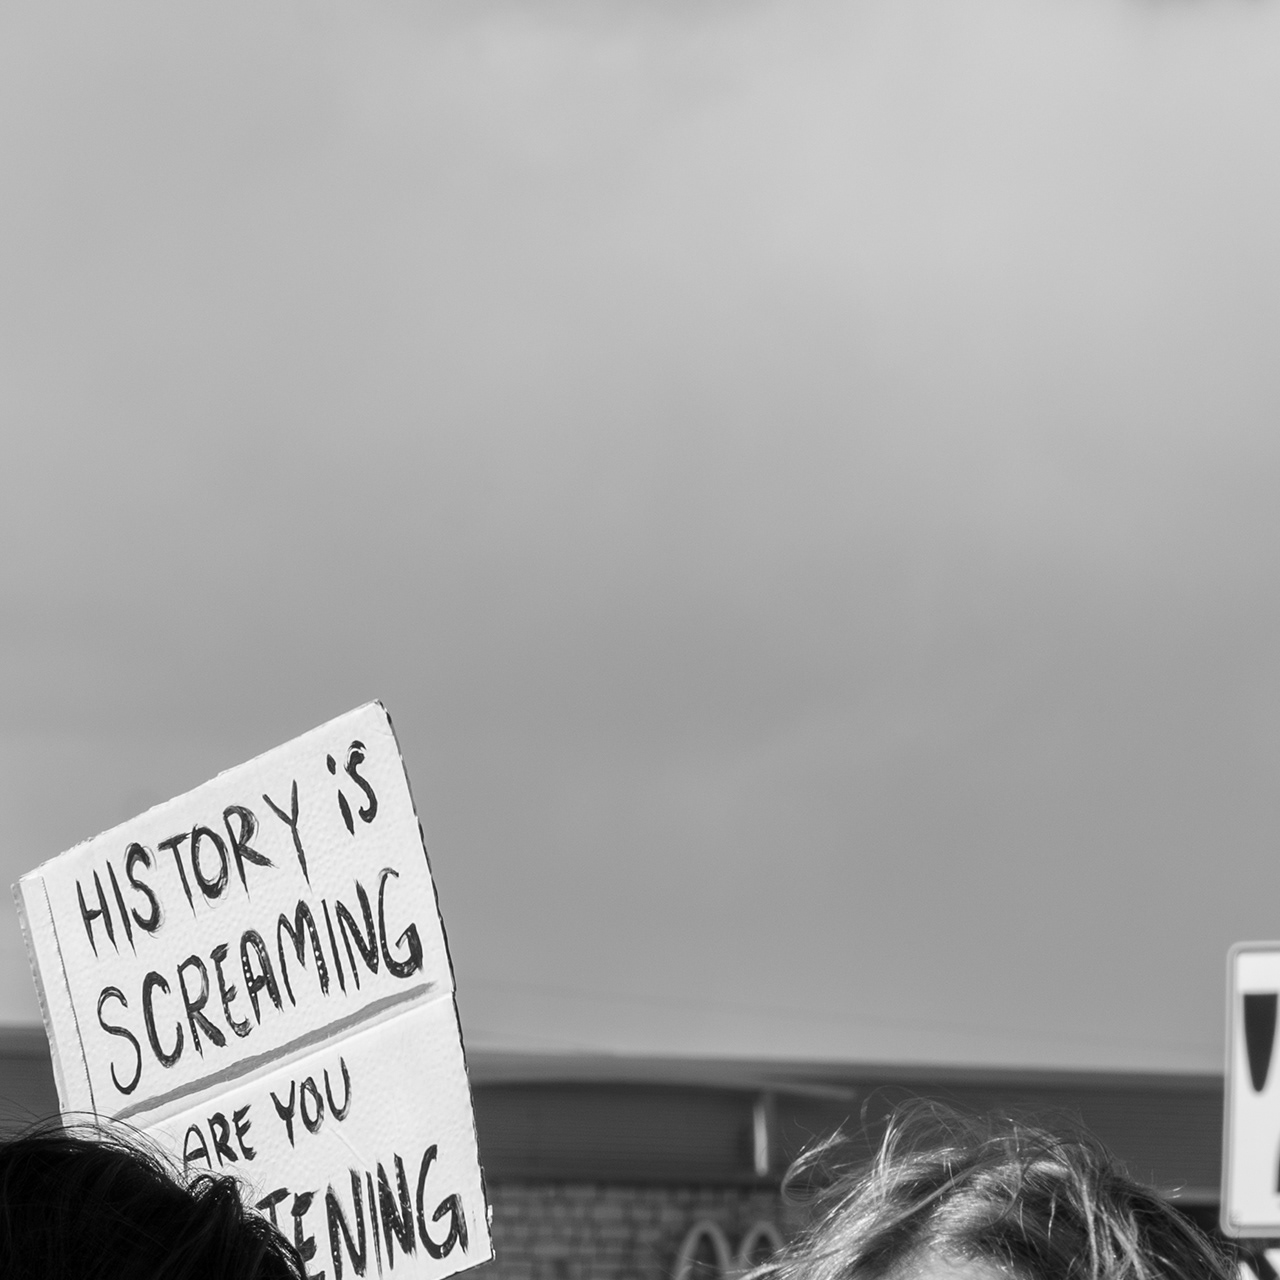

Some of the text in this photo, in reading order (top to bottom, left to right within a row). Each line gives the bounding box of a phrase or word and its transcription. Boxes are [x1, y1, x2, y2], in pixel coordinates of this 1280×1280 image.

[75, 779, 313, 958] HISTORY
[97, 867, 424, 1095] SCREAMING
[183, 1056, 353, 1172] ARE YOU
